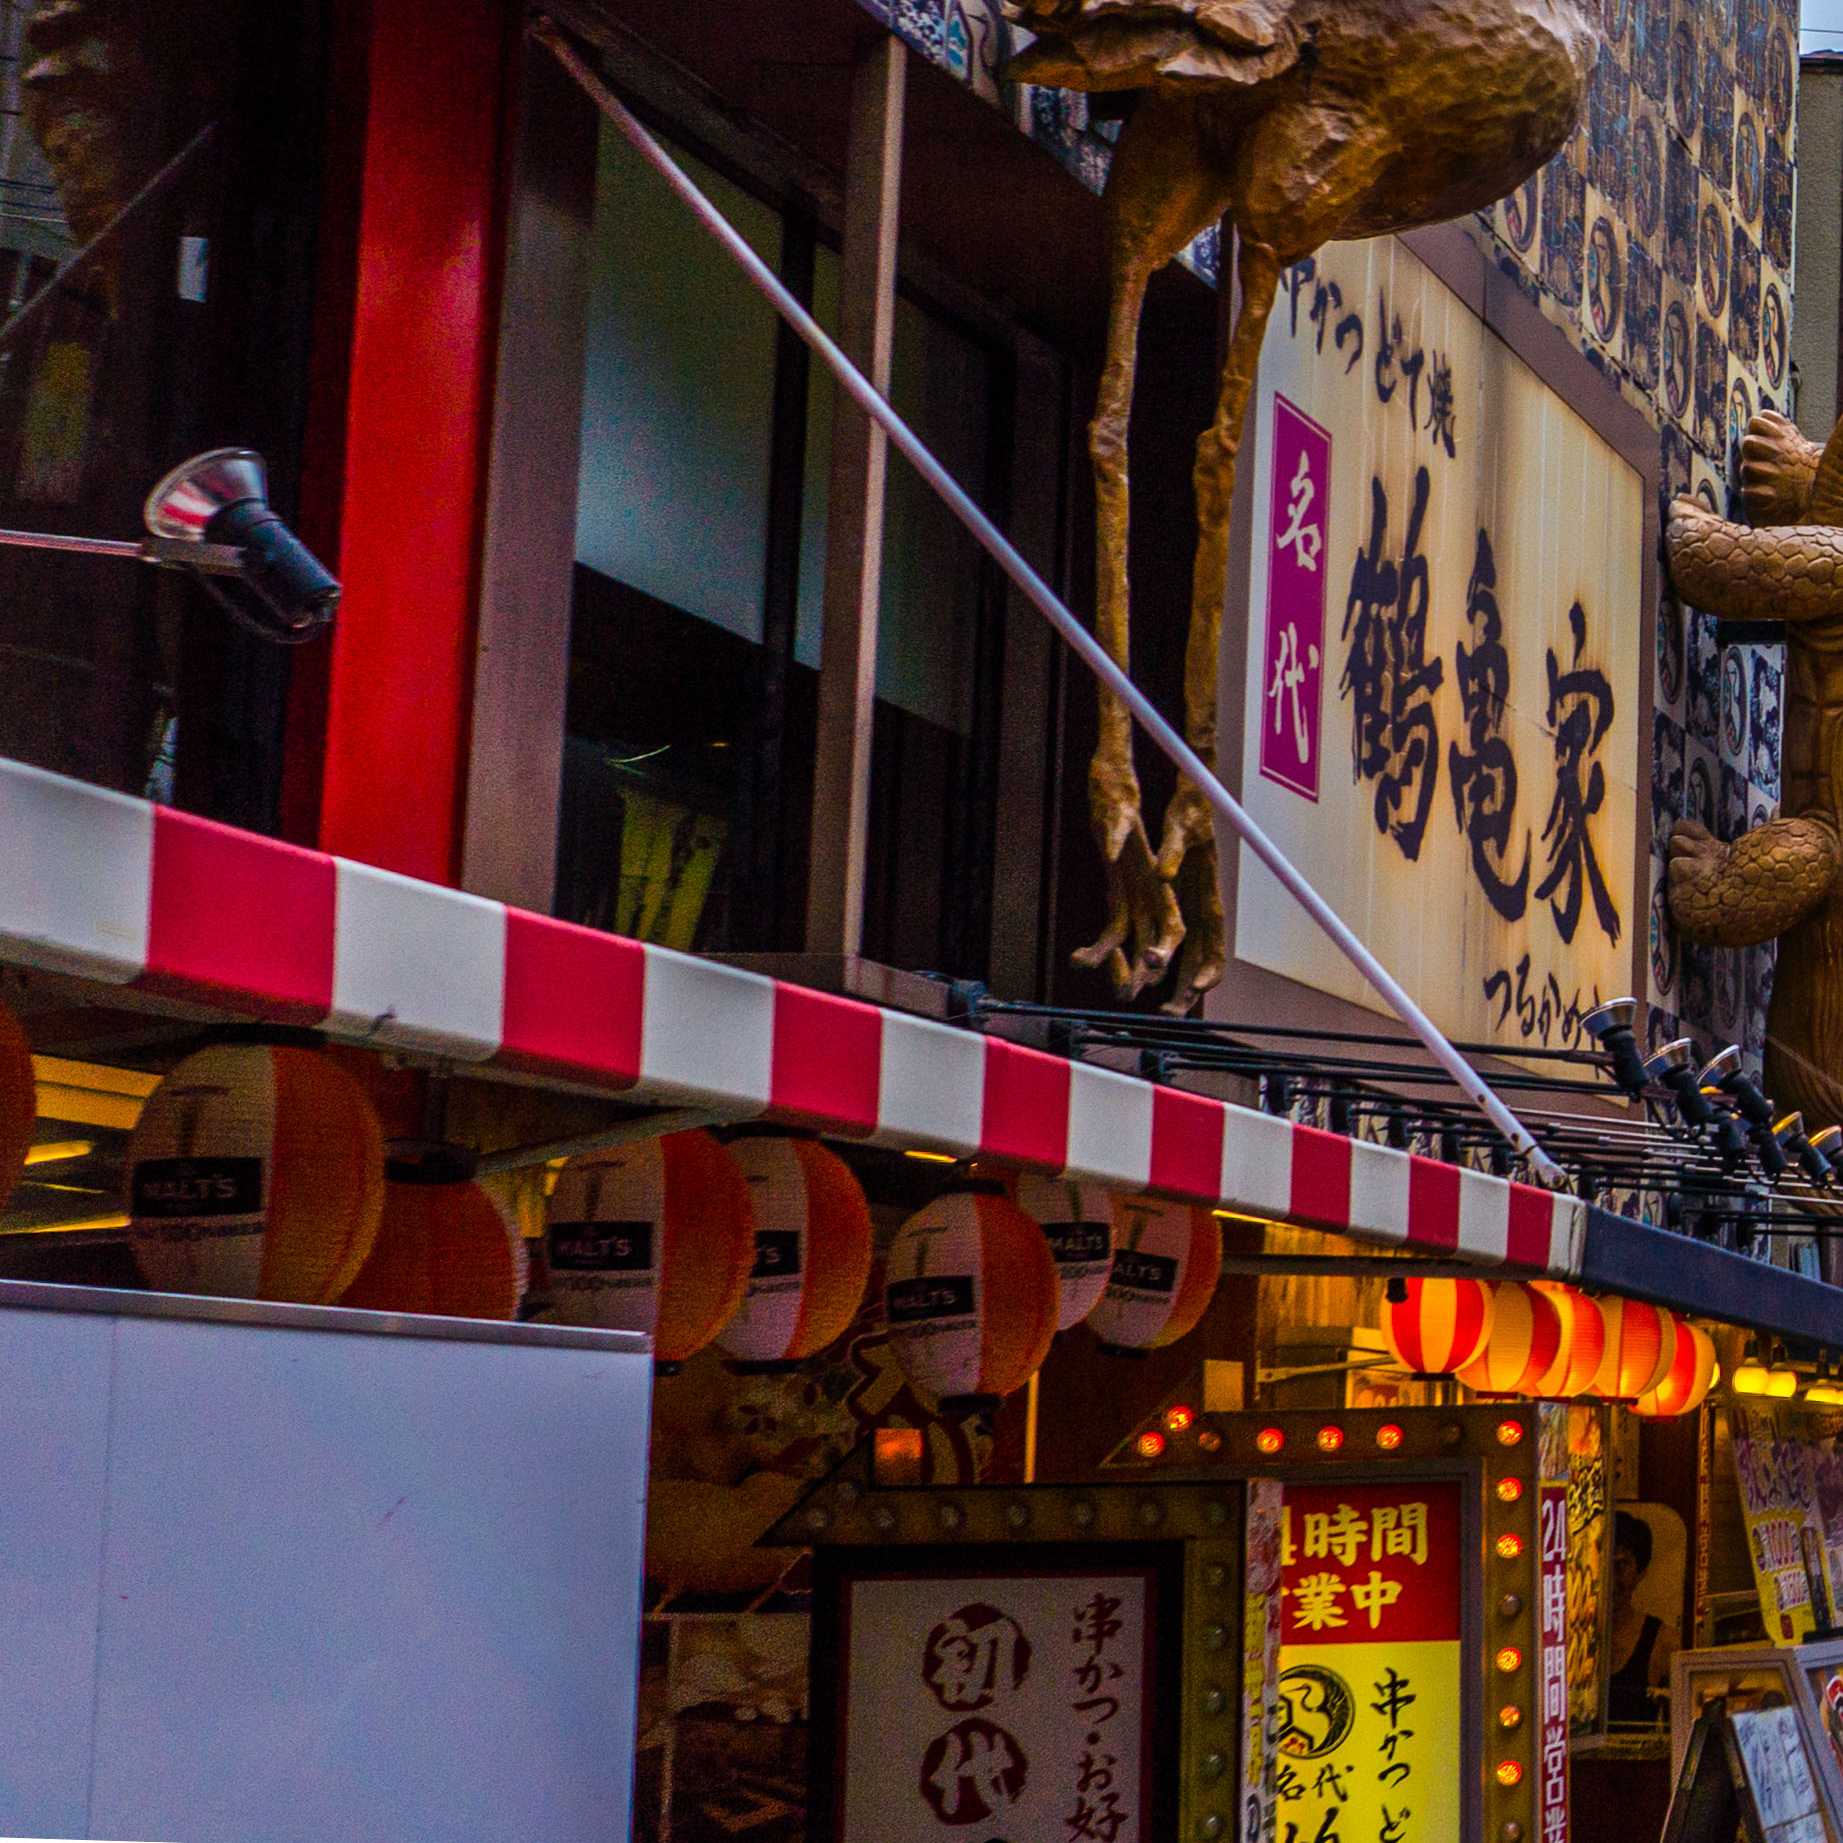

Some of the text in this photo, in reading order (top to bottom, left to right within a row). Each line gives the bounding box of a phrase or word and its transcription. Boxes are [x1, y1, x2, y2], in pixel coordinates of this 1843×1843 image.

[1267, 449, 1329, 766] 名代
[1338, 465, 1622, 948] 鶴亀家
[1113, 1261, 1162, 1282] ALT'S
[1281, 1501, 1429, 1568] 4時間
[1281, 1570, 1404, 1632] 業中
[1370, 1667, 1418, 1790] 串かつ
